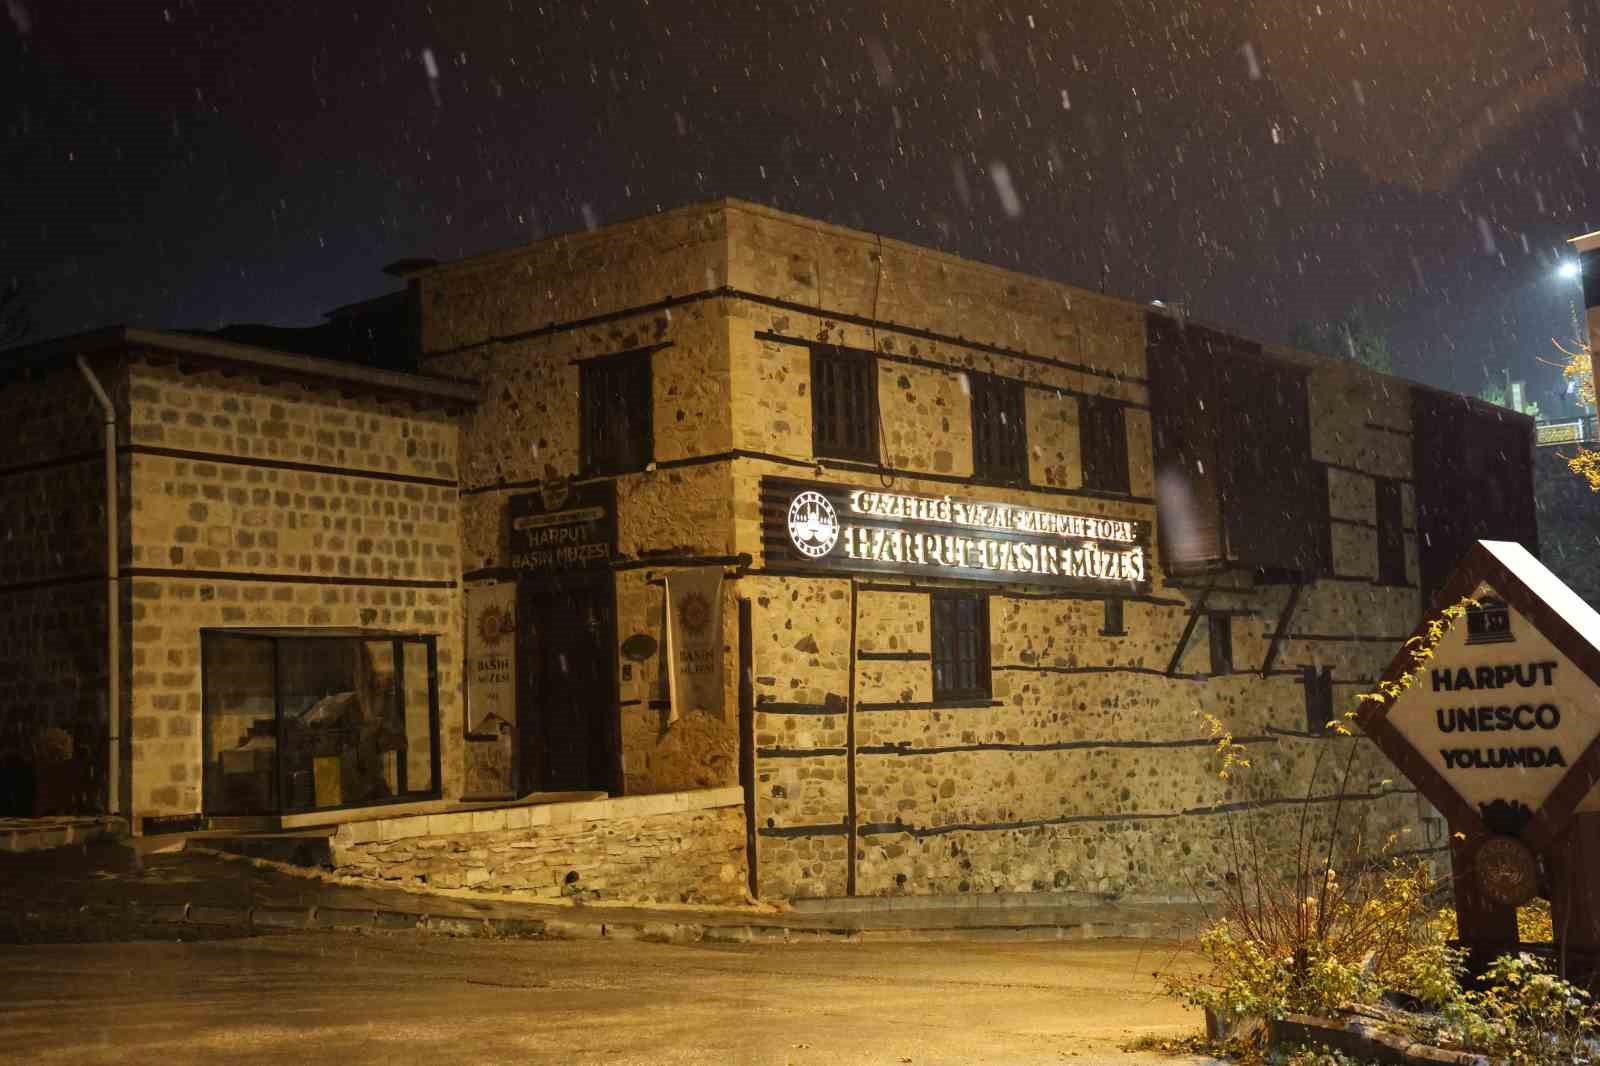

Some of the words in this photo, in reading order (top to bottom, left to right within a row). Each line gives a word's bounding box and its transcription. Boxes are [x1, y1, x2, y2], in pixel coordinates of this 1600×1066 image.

[848, 525, 982, 568] HARPUT
[1431, 661, 1558, 692] HARPUT
[1436, 703, 1561, 733] UNESCO
[1440, 745, 1568, 769] YOLUNDA
